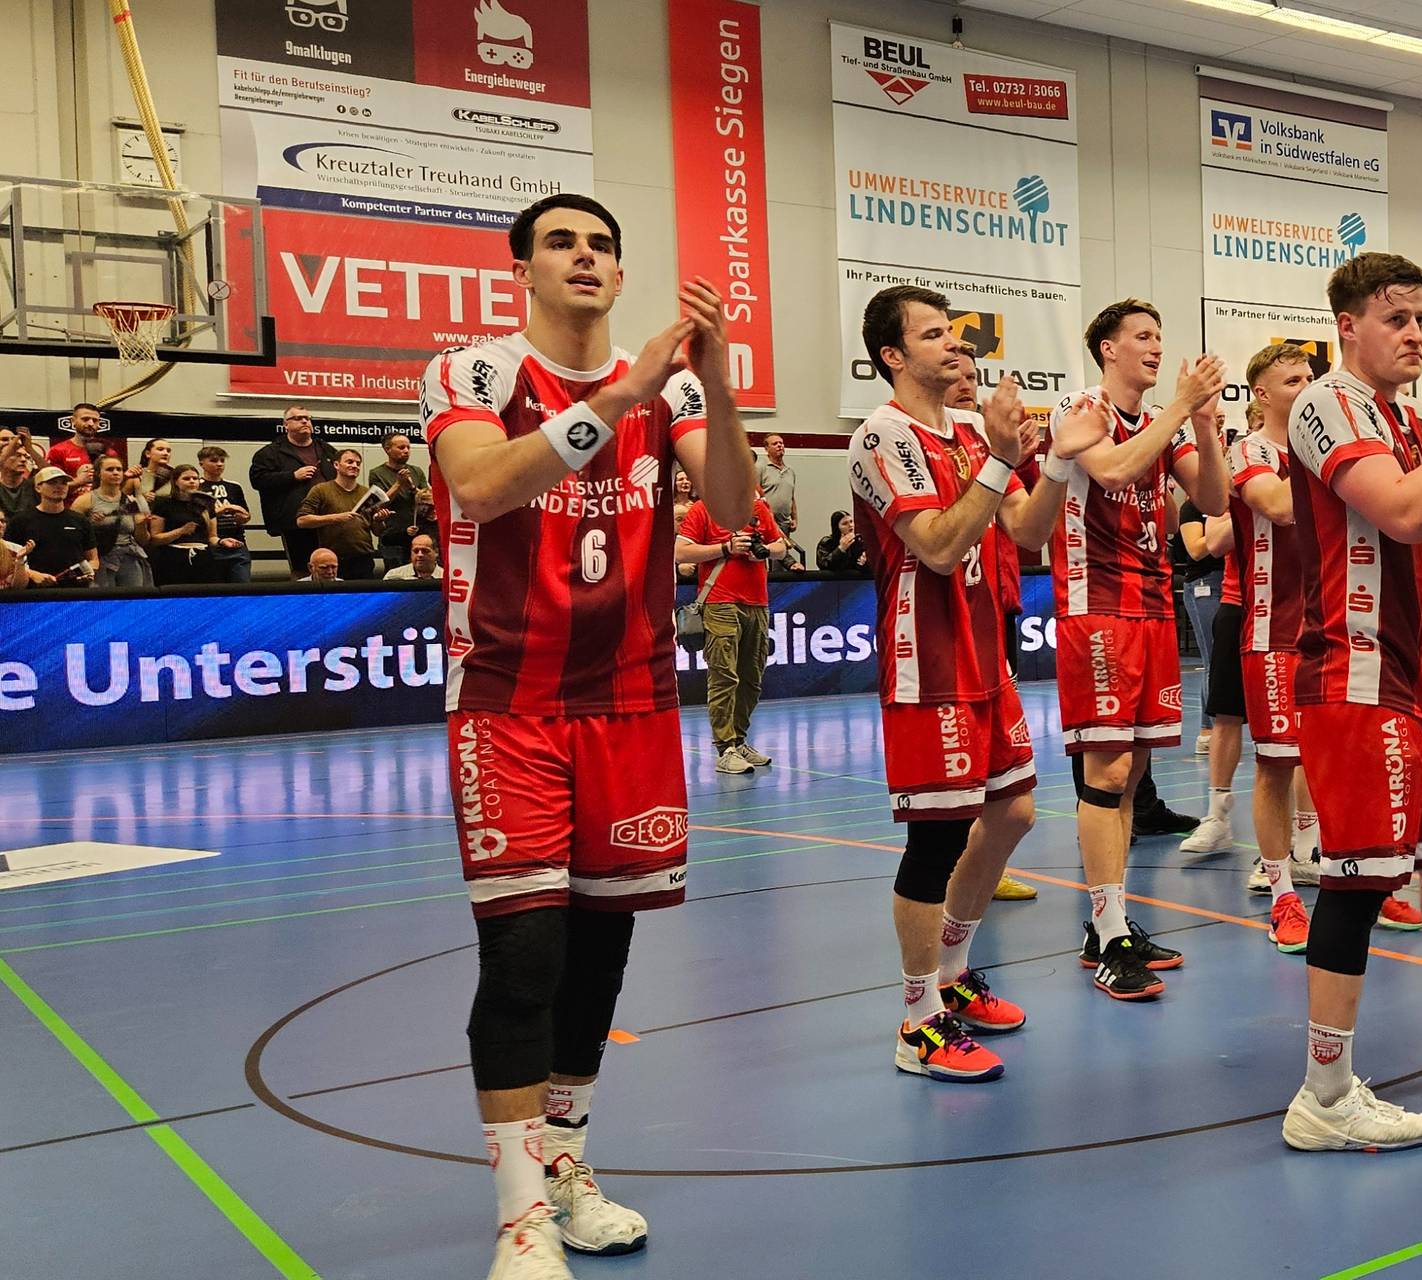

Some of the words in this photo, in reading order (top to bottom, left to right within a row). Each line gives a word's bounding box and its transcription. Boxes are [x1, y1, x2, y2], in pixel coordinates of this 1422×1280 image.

[841, 55, 861, 66] Tief-
[863, 57, 879, 70] und
[928, 73, 952, 84] GmbH
[863, 36, 931, 70] BEUL
[234, 69, 248, 81] Fit
[251, 72, 265, 83] für
[269, 76, 288, 86] den
[292, 77, 371, 98] Berufseinstieg?
[465, 68, 546, 95] Energiebeweger
[713, 18, 749, 139] Siegen
[969, 79, 990, 94] Tel.
[992, 81, 1026, 96] 02732
[1034, 84, 1061, 98] 3066
[977, 96, 1057, 111] www.beul-bau.de
[1259, 119, 1325, 144] Volksbank
[1260, 139, 1272, 154] in
[1275, 142, 1360, 169] Südwestfalen
[1363, 158, 1380, 172] eG
[316, 152, 414, 179] Kreuztaler
[419, 165, 502, 190] Treuhand
[510, 176, 561, 195] GmbH
[848, 169, 1008, 210] UMWELTSERVICE
[341, 197, 412, 214] Kompetenter
[415, 205, 452, 218] Partner
[455, 208, 473, 220] des
[719, 147, 758, 323] Sparkasse
[1212, 213, 1334, 243] UMWELTSERVICE
[1213, 234, 1347, 268] LINDENSCHM
[280, 251, 530, 327] VETTE
[846, 269, 863, 281] Ihr
[865, 271, 911, 286] Partner
[914, 276, 931, 287] für
[934, 278, 1028, 298] wirtschaftliches
[1031, 288, 1067, 302] Bauen.
[1215, 307, 1228, 316] Ihr
[1231, 308, 1265, 320] Partner
[1267, 311, 1280, 321] für
[283, 370, 355, 388] VETTER
[324, 424, 382, 436] technisch
[581, 529, 607, 583] 6
[1104, 629, 1119, 692] COATINGS
[956, 709, 970, 747] COAT
[477, 718, 503, 820] COATINGS
[1397, 716, 1411, 806] COATINGS
